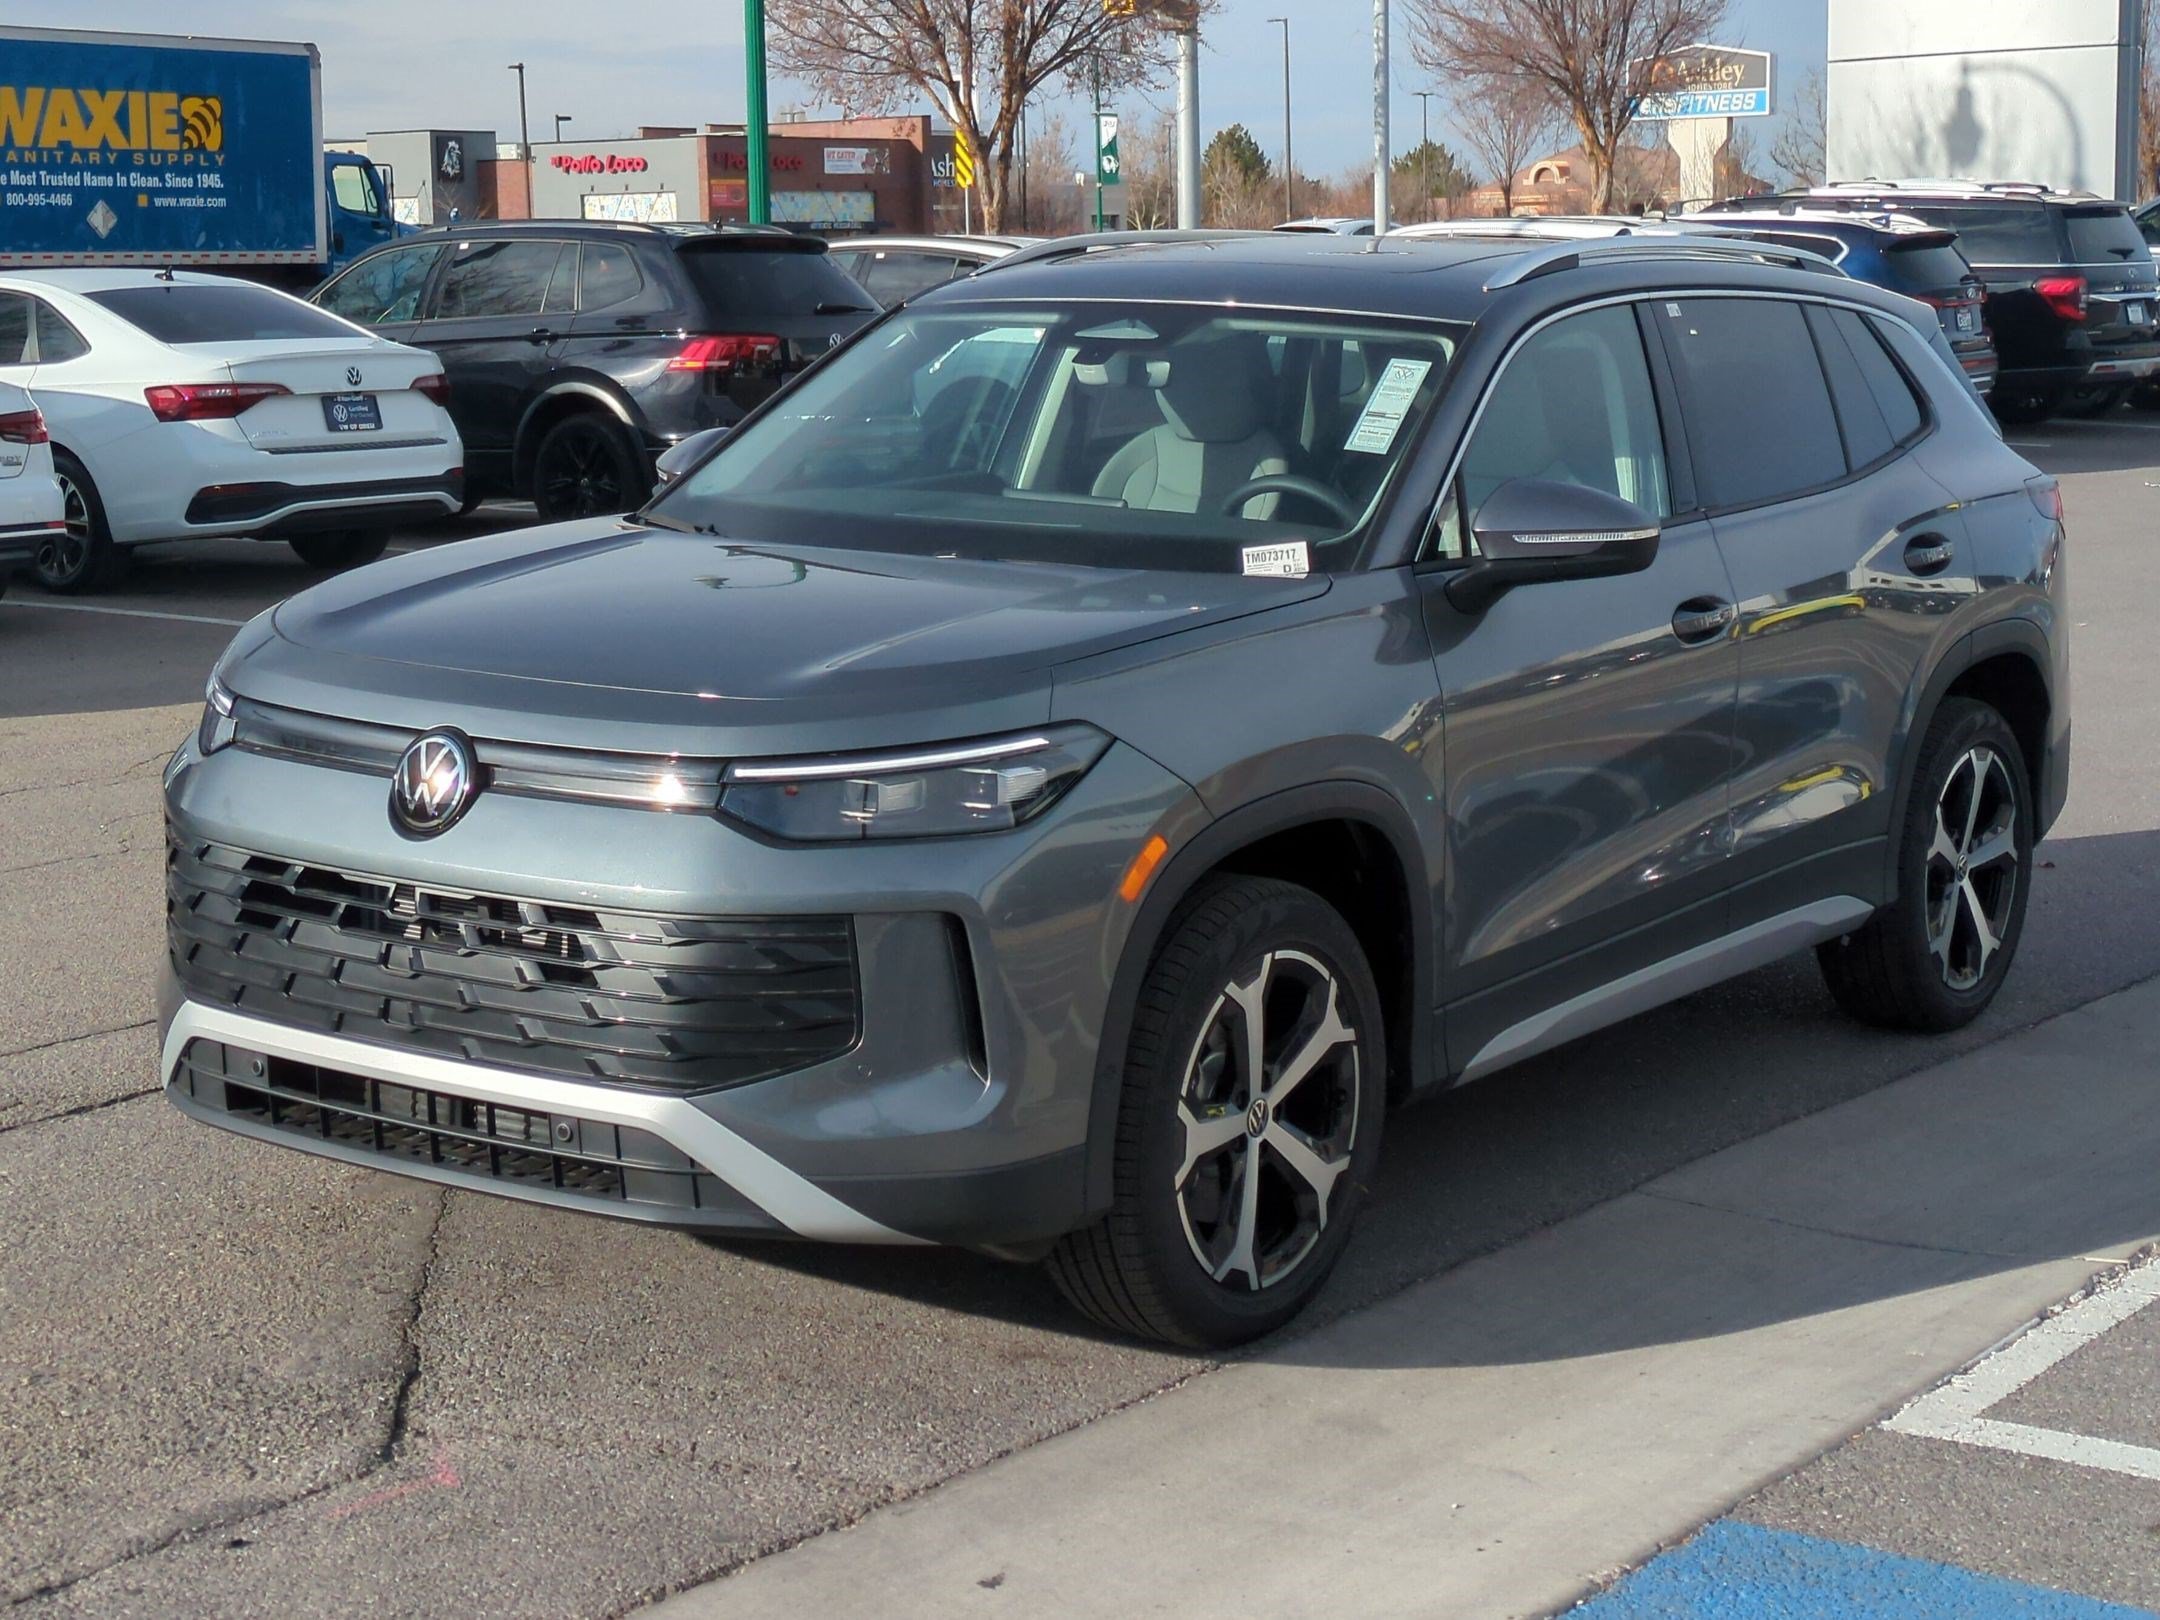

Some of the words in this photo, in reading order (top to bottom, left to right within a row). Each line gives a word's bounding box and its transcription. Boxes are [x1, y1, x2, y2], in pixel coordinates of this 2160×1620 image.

[1677, 56, 1745, 87] Aley
[1677, 92, 1757, 113] FITNESS
[6, 151, 117, 165] ANITARY
[133, 152, 224, 166] SUPPLY
[10, 170, 36, 186] Most
[39, 171, 81, 187] Trusted
[83, 171, 113, 187] Name
[117, 172, 127, 187] In
[130, 172, 162, 187] Clean.
[165, 173, 194, 188] Since
[197, 173, 224, 188] 1945.
[6, 193, 73, 206] 800-995-4466
[154, 195, 227, 208] www.waxie.com
[1245, 549, 1296, 564] TM073717
